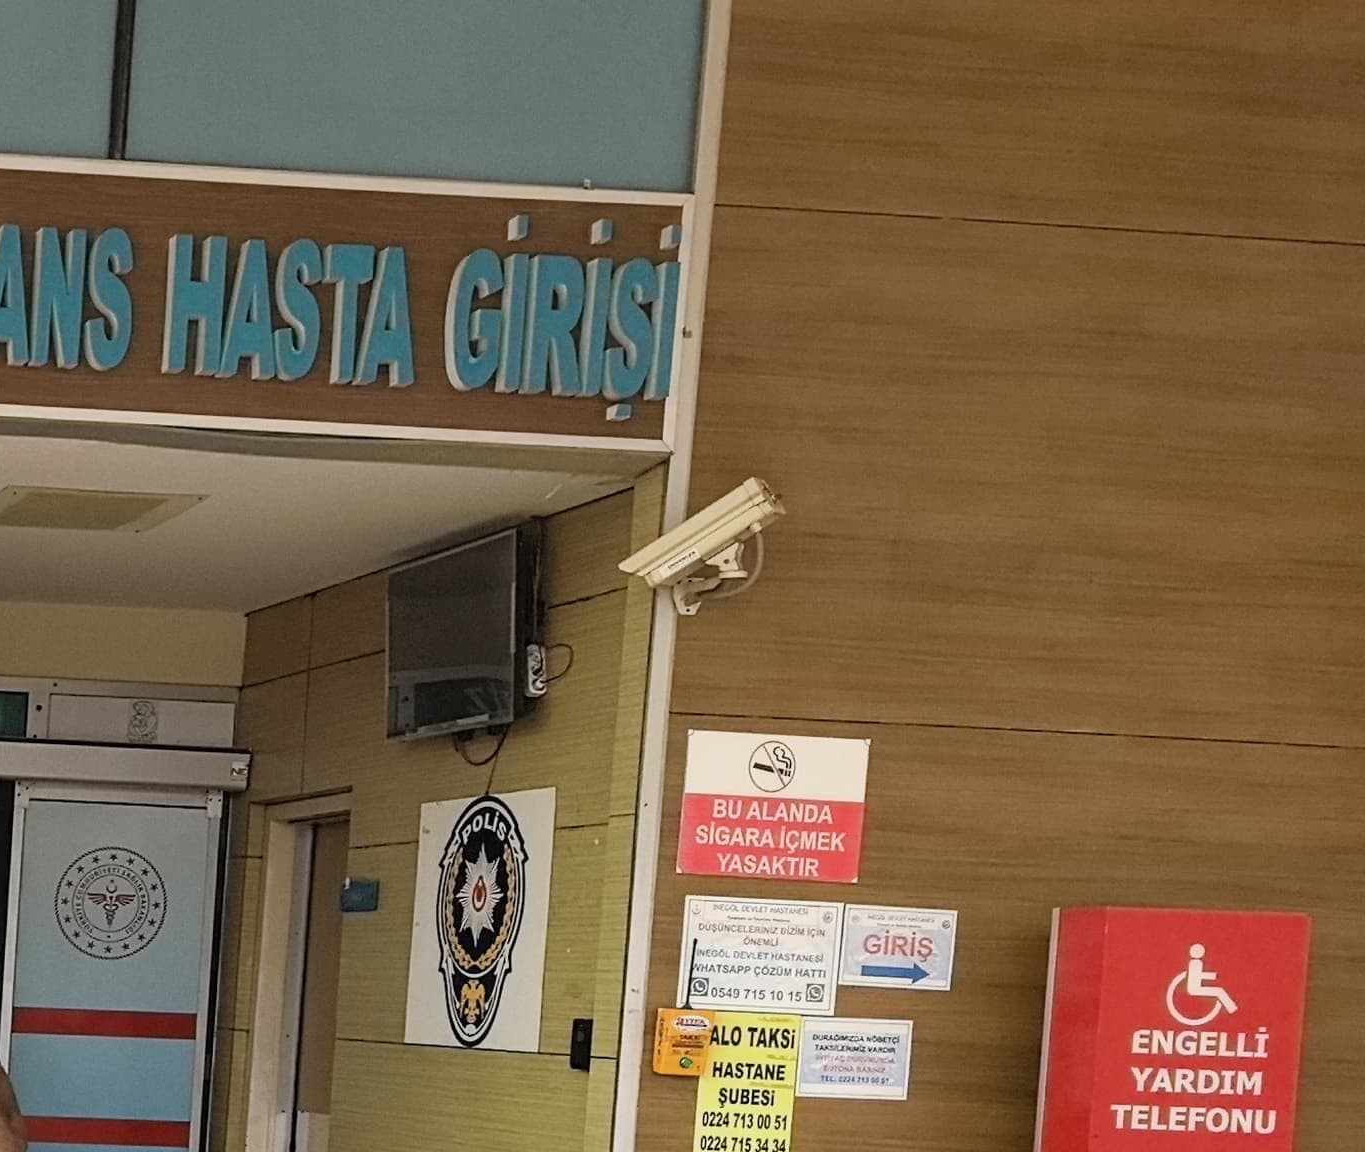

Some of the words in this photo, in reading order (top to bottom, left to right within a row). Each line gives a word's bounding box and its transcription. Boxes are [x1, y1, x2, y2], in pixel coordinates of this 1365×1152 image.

[161, 233, 415, 388] HASTA
[444, 214, 681, 421] GİRİŞİ
[712, 799, 742, 820] BU
[748, 800, 834, 824] ALANDA
[695, 822, 775, 849] SİGARA
[779, 825, 846, 854] İÇMEK
[717, 853, 819, 876] YASAKTIR
[863, 930, 934, 962] GİRİŞ
[692, 963, 751, 975] WHATSAPP
[794, 968, 827, 978] HATTI
[711, 987, 740, 999] 0549
[744, 989, 766, 1000] 715
[770, 990, 784, 1001] 10
[788, 991, 802, 1002] 15
[709, 1025, 742, 1046] ALO
[1131, 1027, 1269, 1058] ENGELLİ
[712, 1061, 786, 1081] HASTANE
[1131, 1066, 1263, 1096] YARDIM
[702, 1111, 730, 1128] 0224
[733, 1113, 754, 1129] 713
[757, 1114, 771, 1130] 00
[774, 1114, 787, 1130] 51
[1110, 1104, 1277, 1134] TELEFONU
[700, 1135, 727, 1152] 0224
[731, 1137, 751, 1152] 715
